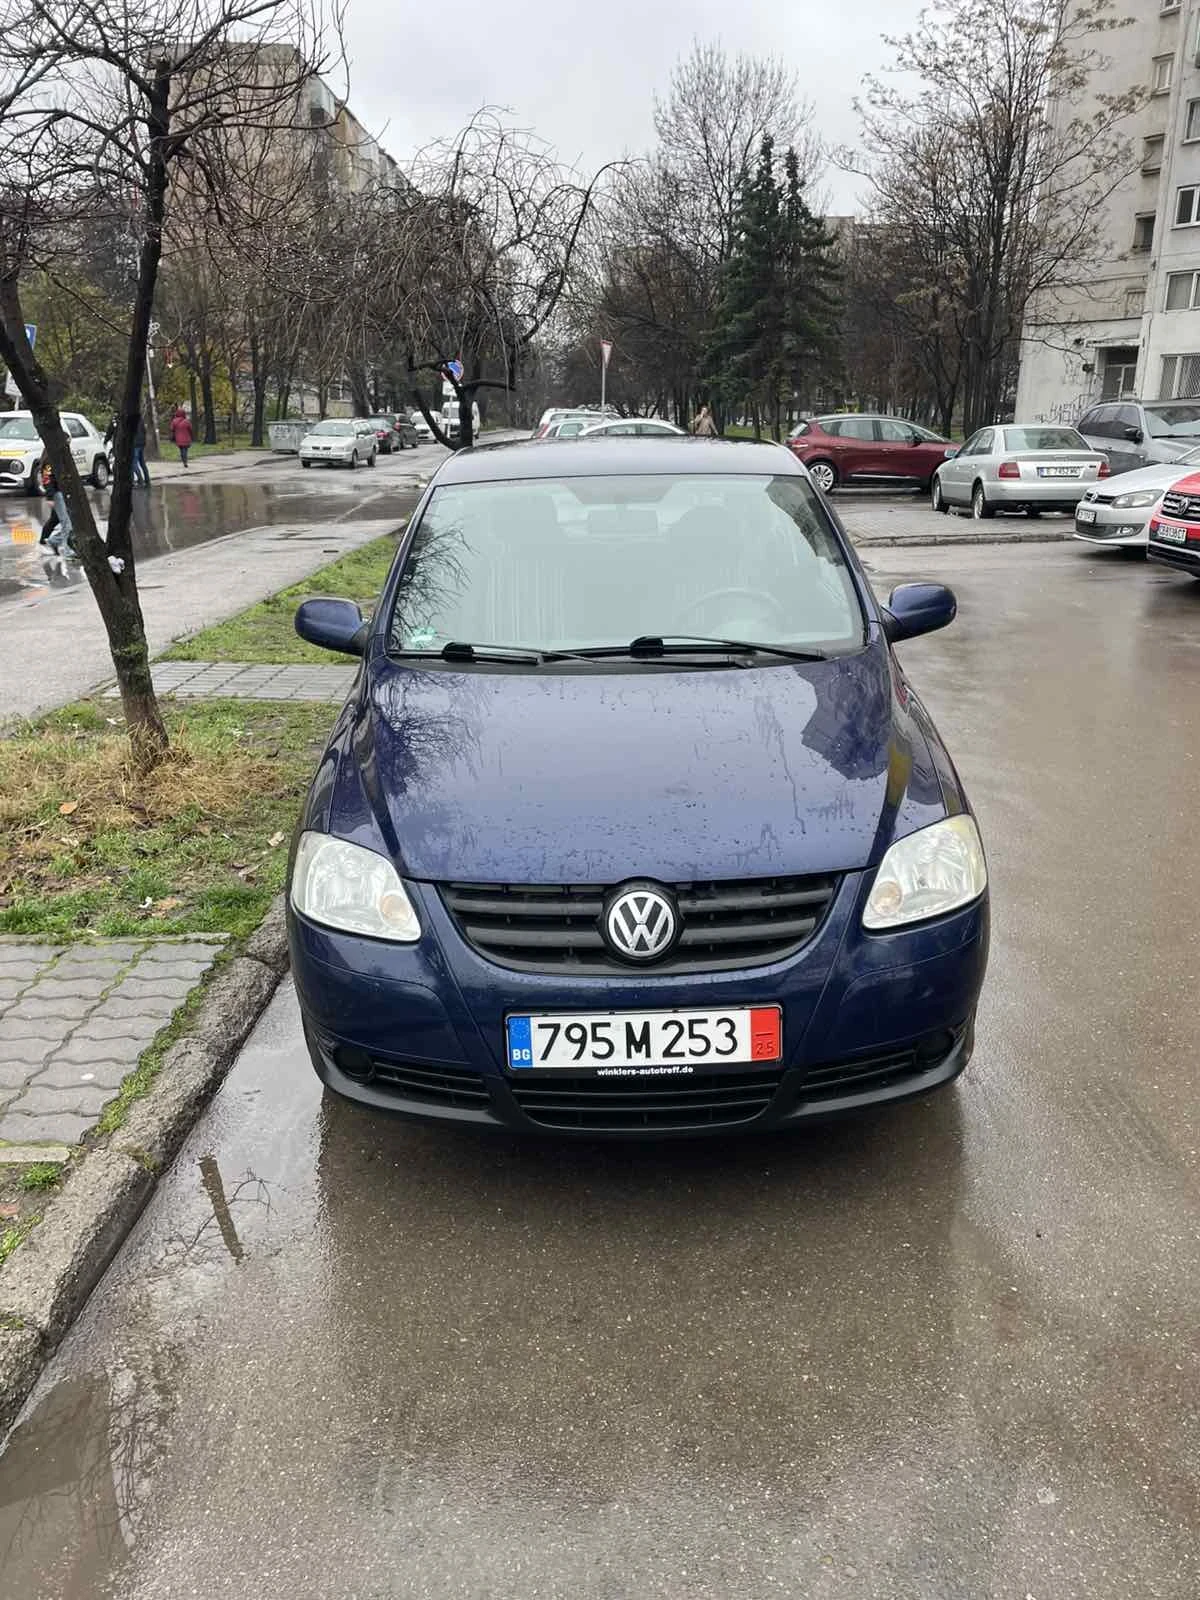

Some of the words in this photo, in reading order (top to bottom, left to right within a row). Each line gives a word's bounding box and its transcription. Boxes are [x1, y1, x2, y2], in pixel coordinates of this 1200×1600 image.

[609, 891, 674, 957] VW
[513, 1049, 530, 1060] BG
[538, 1022, 615, 1060] 795
[625, 1021, 651, 1059] M
[662, 1018, 738, 1057] 253
[757, 1041, 774, 1056] 25
[597, 1066, 694, 1076] winklers-autotreff.de
